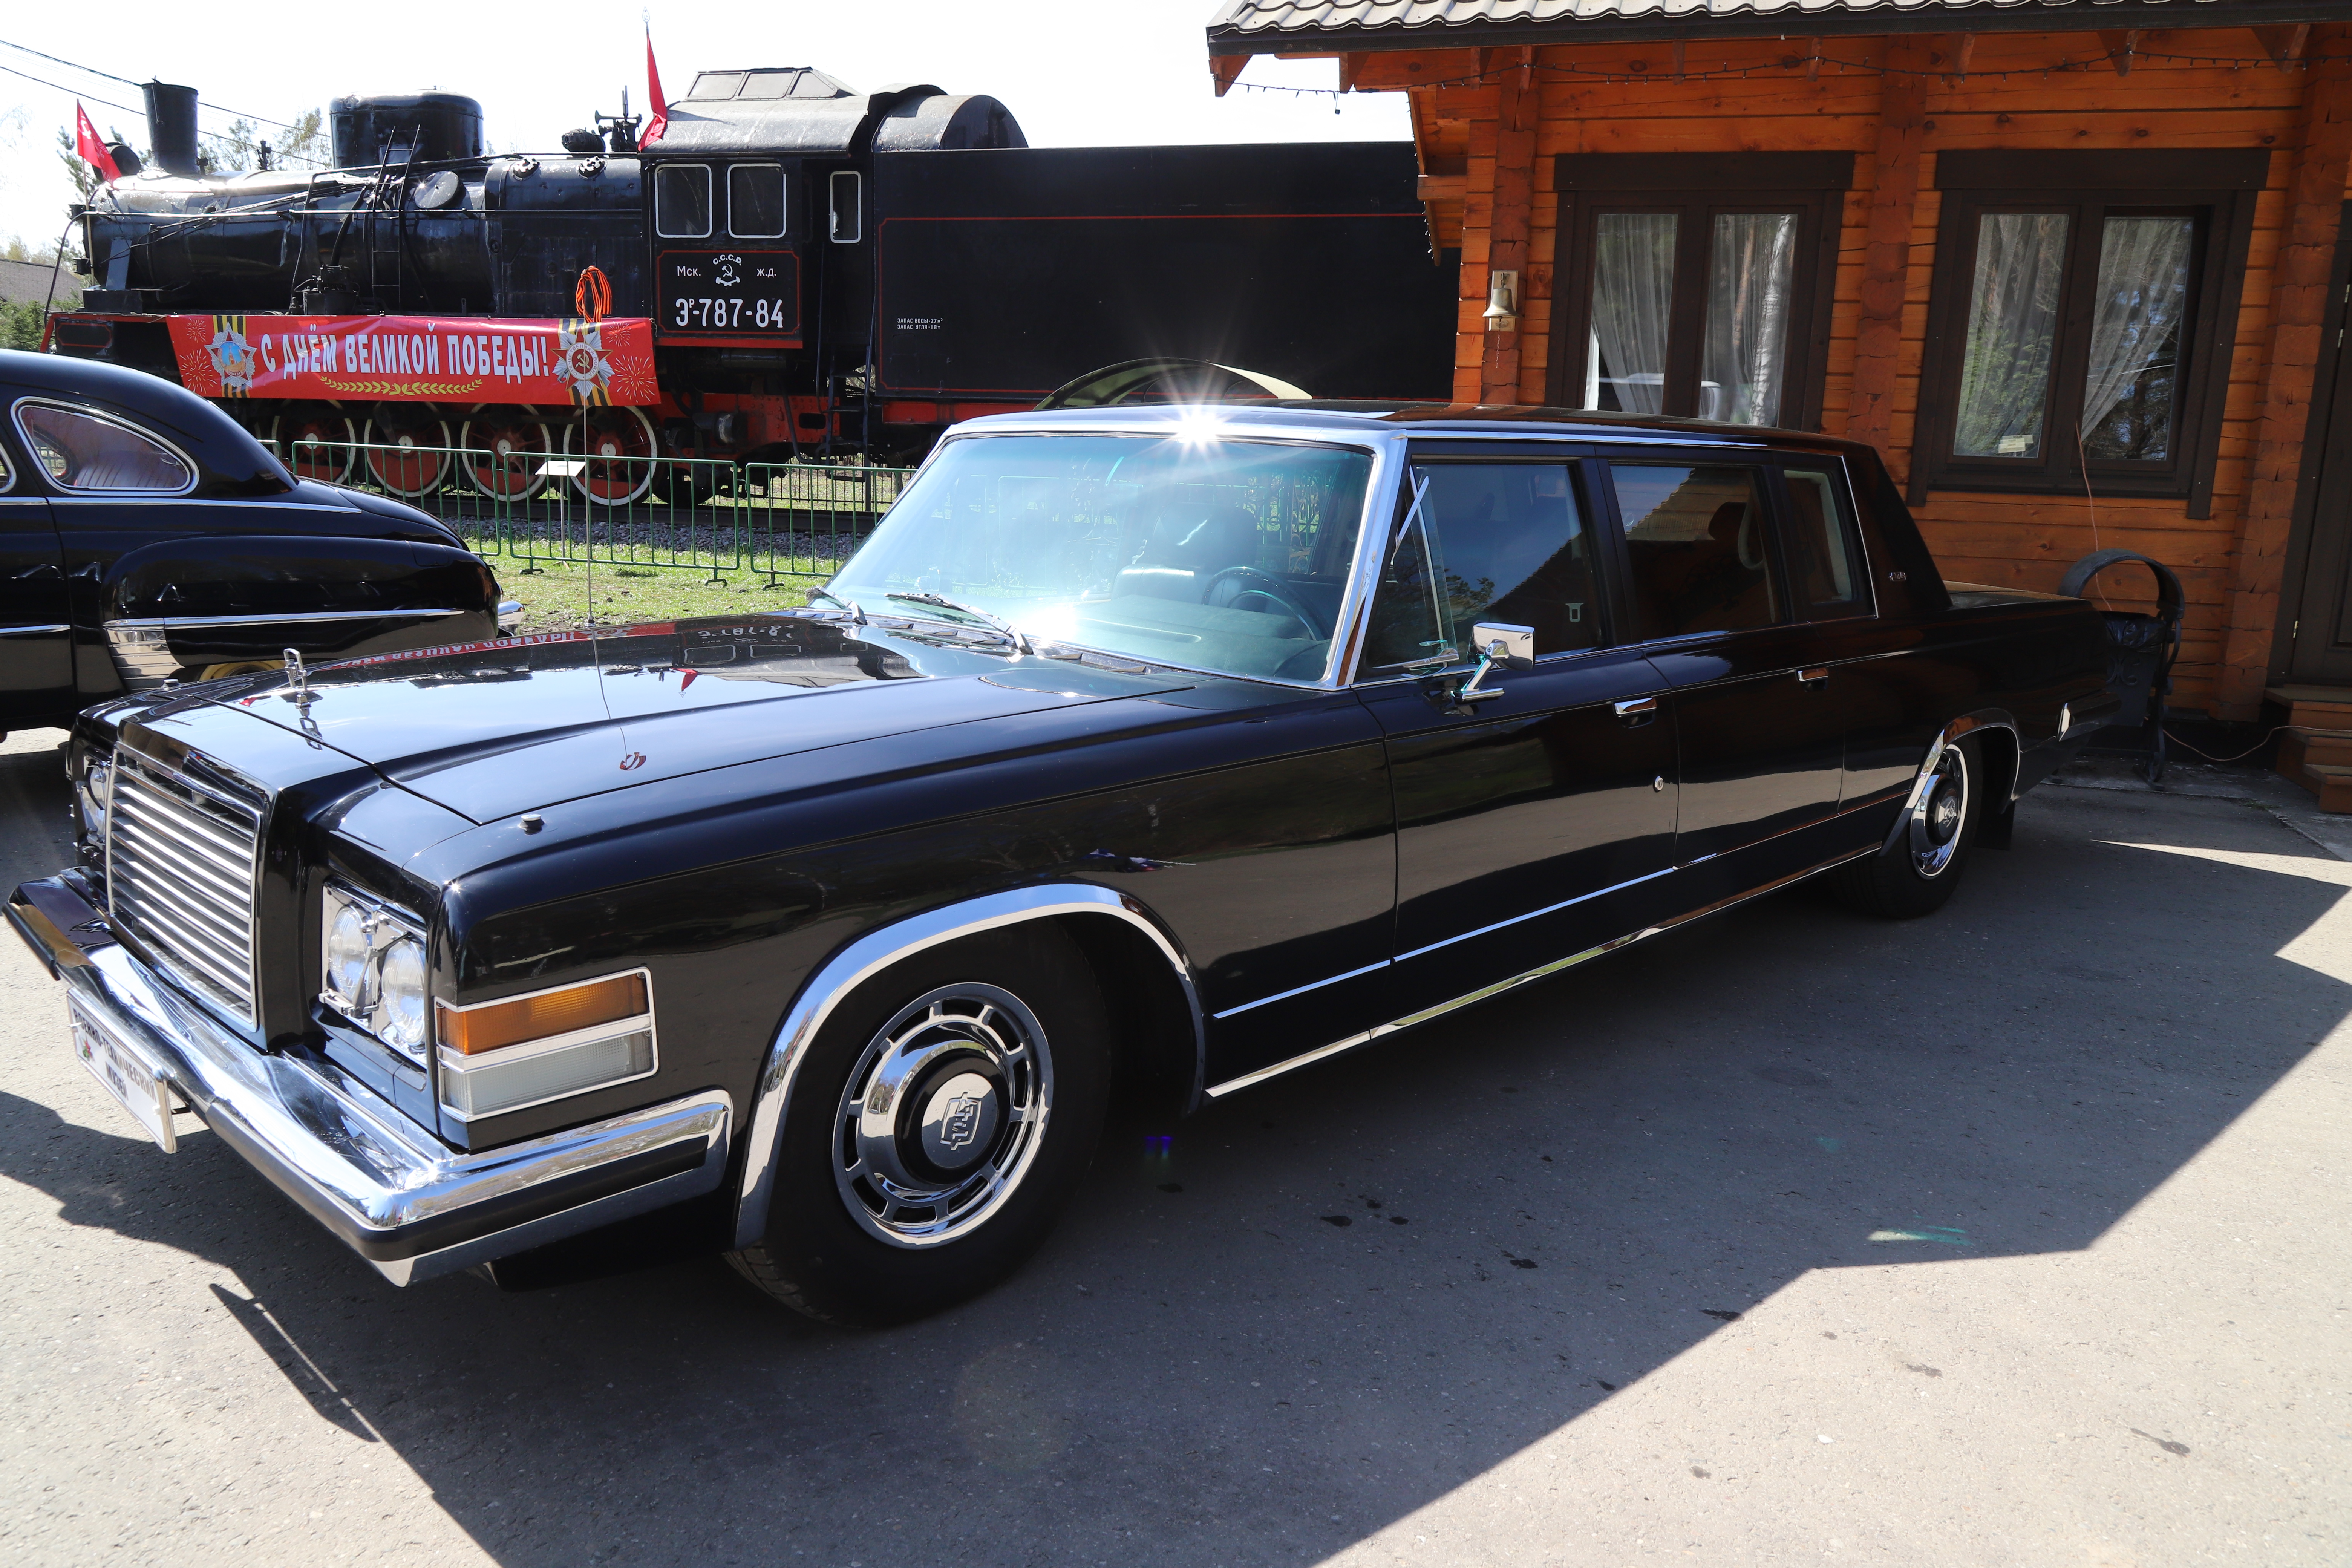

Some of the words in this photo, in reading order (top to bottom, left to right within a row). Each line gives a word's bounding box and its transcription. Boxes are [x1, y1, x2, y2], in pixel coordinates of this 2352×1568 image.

[677, 265, 701, 277] Мск.
[261, 334, 276, 372] С
[282, 323, 338, 380] ДНЁМ
[345, 322, 440, 375] ВЕЛИКОЙ
[447, 335, 550, 384] ПОБЕДЫ!
[567, 344, 595, 376] ОТЕЧЕСТВЕННАЯ
[105, 1061, 129, 1101] МУЗЕЙ
